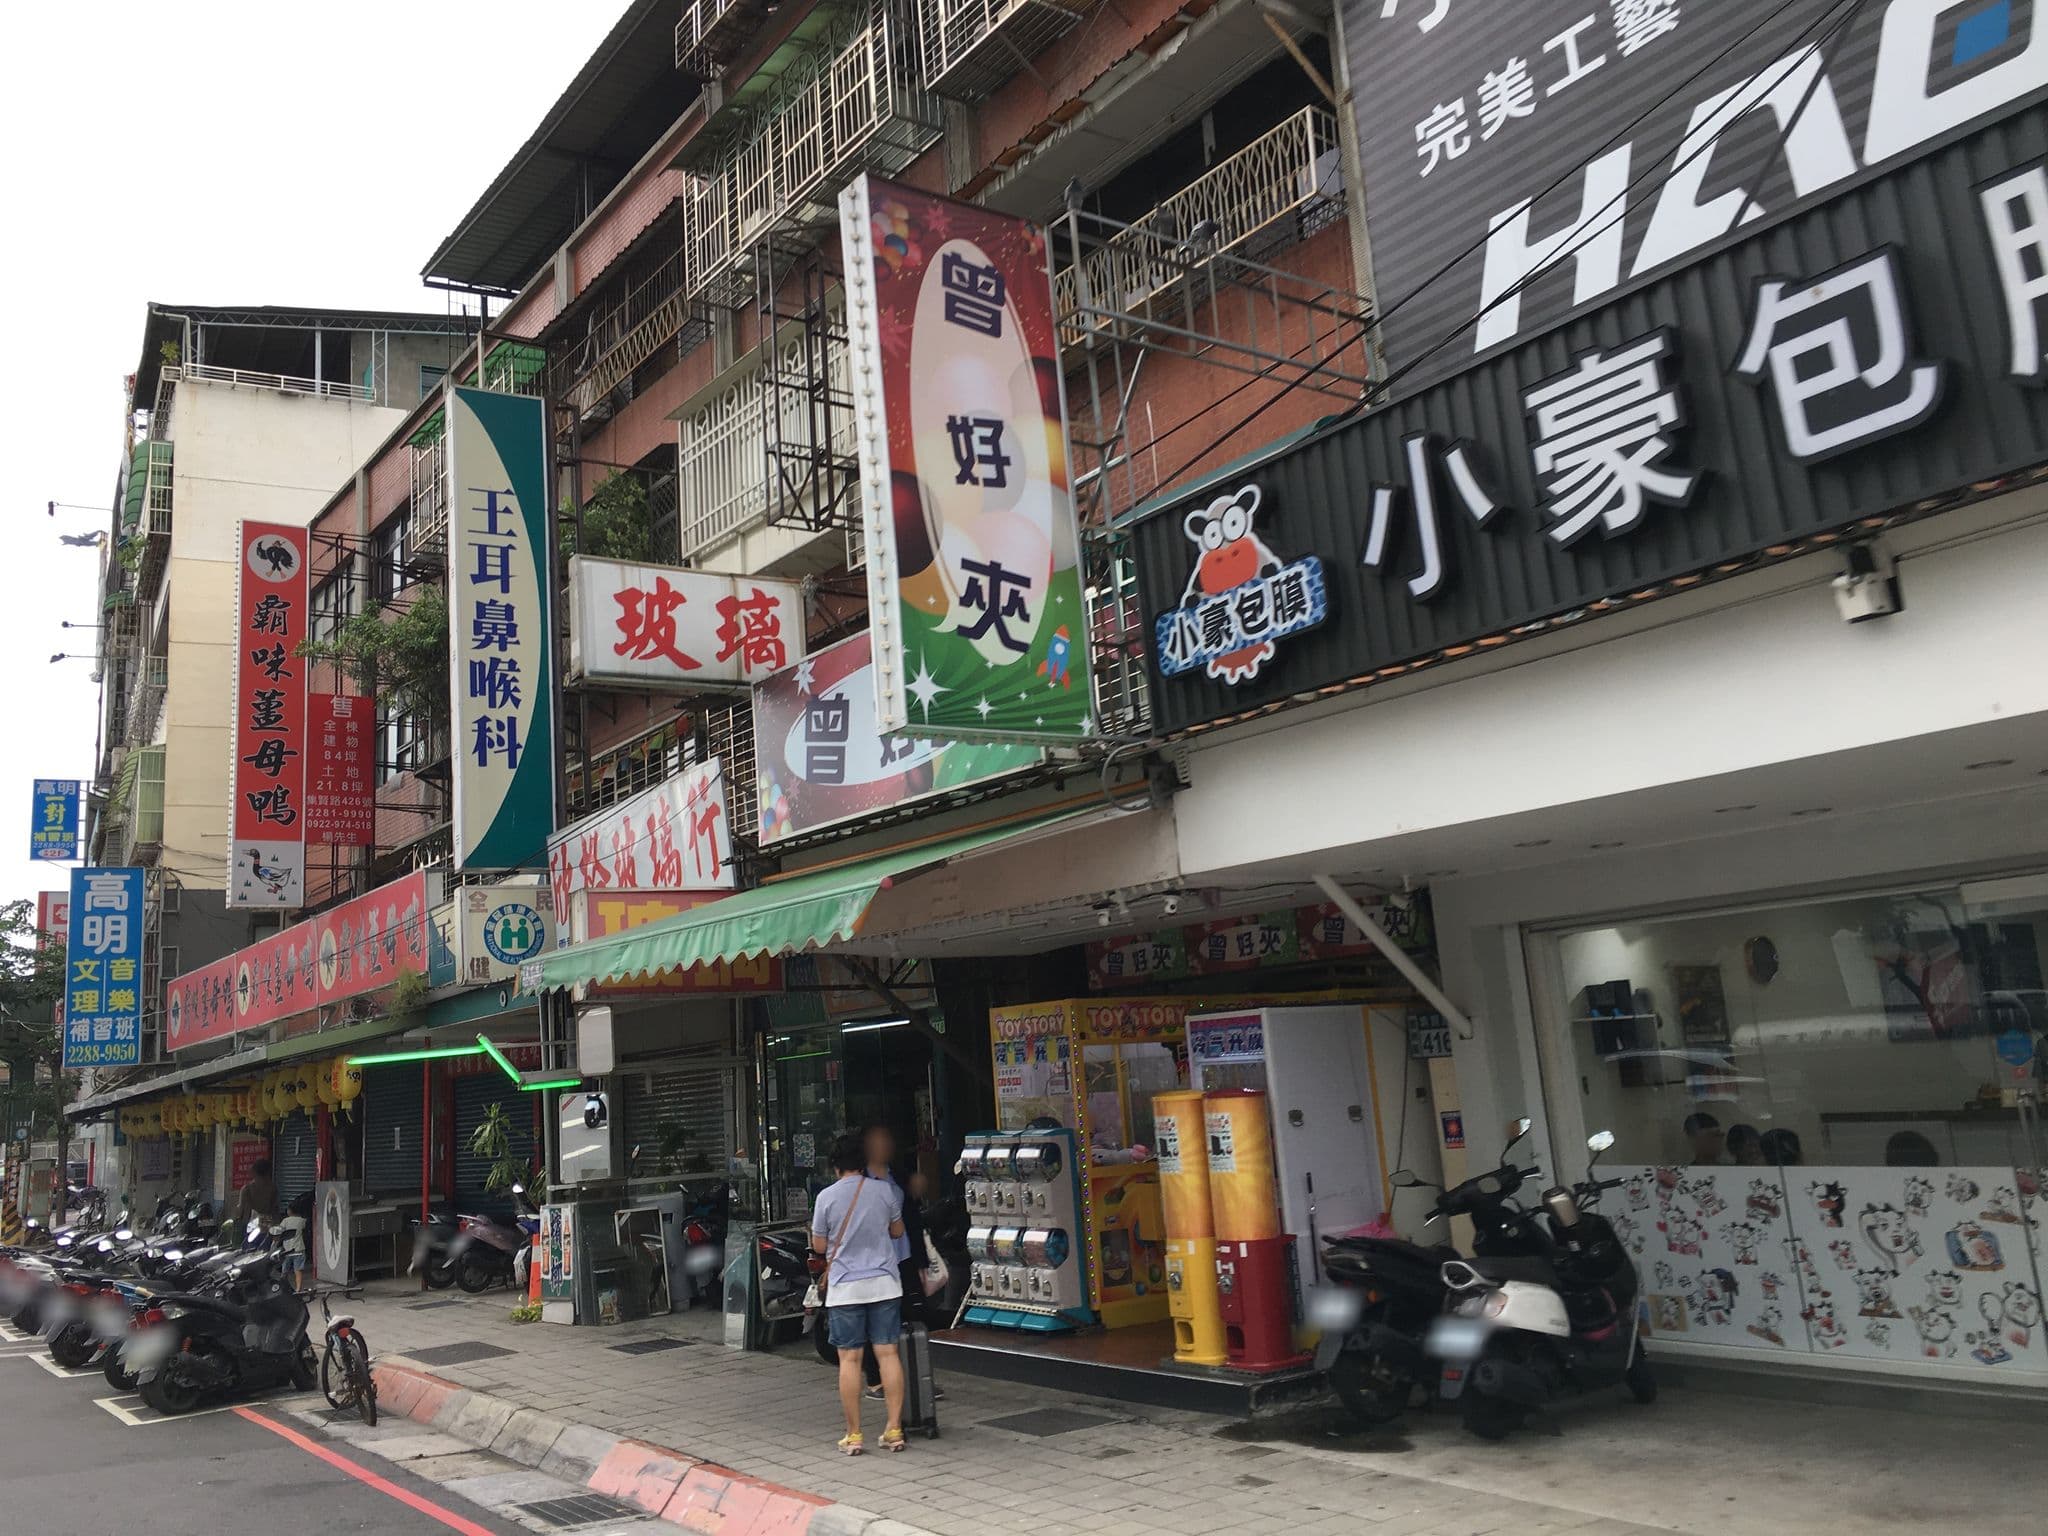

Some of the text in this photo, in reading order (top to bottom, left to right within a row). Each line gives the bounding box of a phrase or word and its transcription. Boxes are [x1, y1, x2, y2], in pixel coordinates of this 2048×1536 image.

[941, 250, 1032, 653] 曾好夾
[467, 486, 523, 770] 王耳鼻喉科
[613, 576, 787, 674] 玻璃
[1166, 569, 1309, 662] 小豪包膜
[243, 594, 298, 826] 霸味薑母鴨
[330, 694, 353, 718] 售
[36, 781, 76, 795] 高明
[82, 872, 131, 955] 高明
[1207, 924, 1283, 961] 曾好夾
[72, 958, 100, 1014] 文理
[108, 957, 137, 1013] 音樂
[69, 1017, 135, 1043] 補習班
[998, 1013, 1066, 1038] TOY STORY
[1087, 1005, 1186, 1029] TOY STORY
[68, 1043, 136, 1065] 2288-9950
